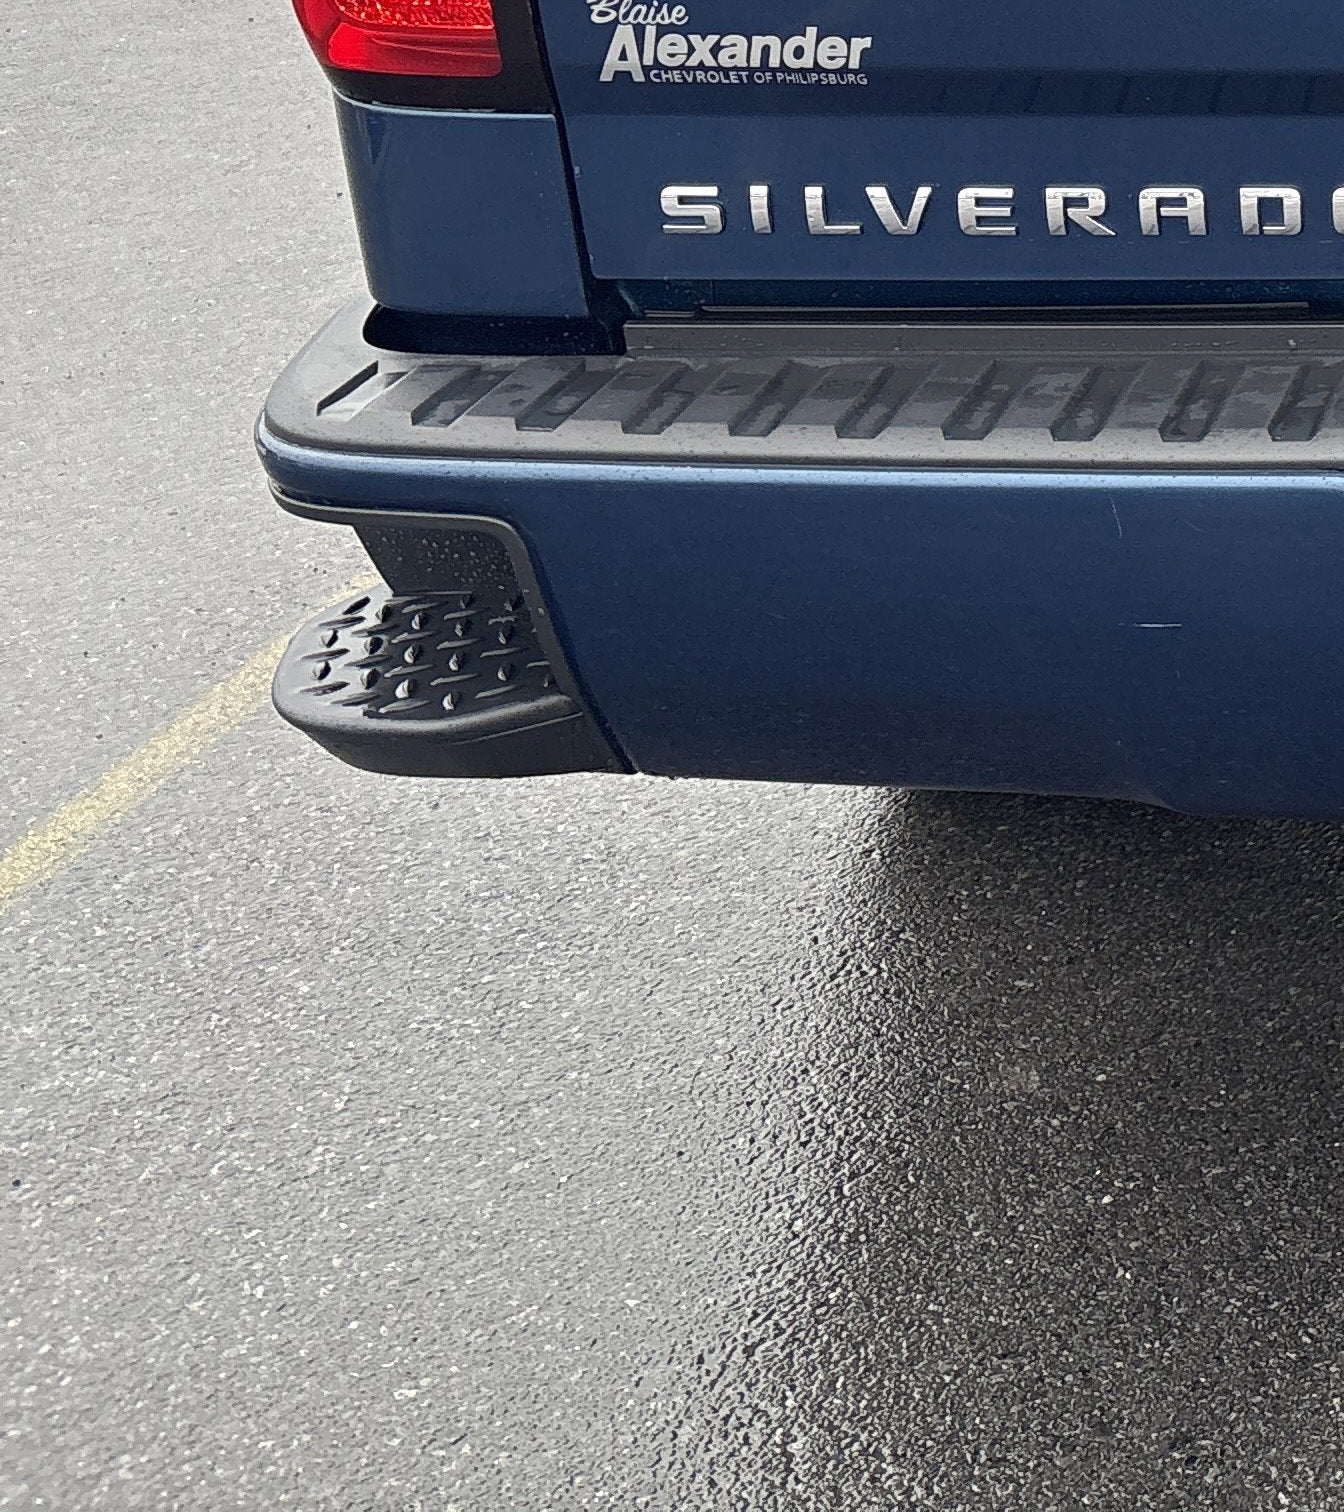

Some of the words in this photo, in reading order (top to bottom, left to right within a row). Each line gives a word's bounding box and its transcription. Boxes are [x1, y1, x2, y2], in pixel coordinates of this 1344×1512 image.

[599, 24, 873, 83] Alexander
[650, 69, 749, 84] CHEVROLET
[754, 71, 774, 84] OF
[776, 71, 869, 86] PHILIPSBURG
